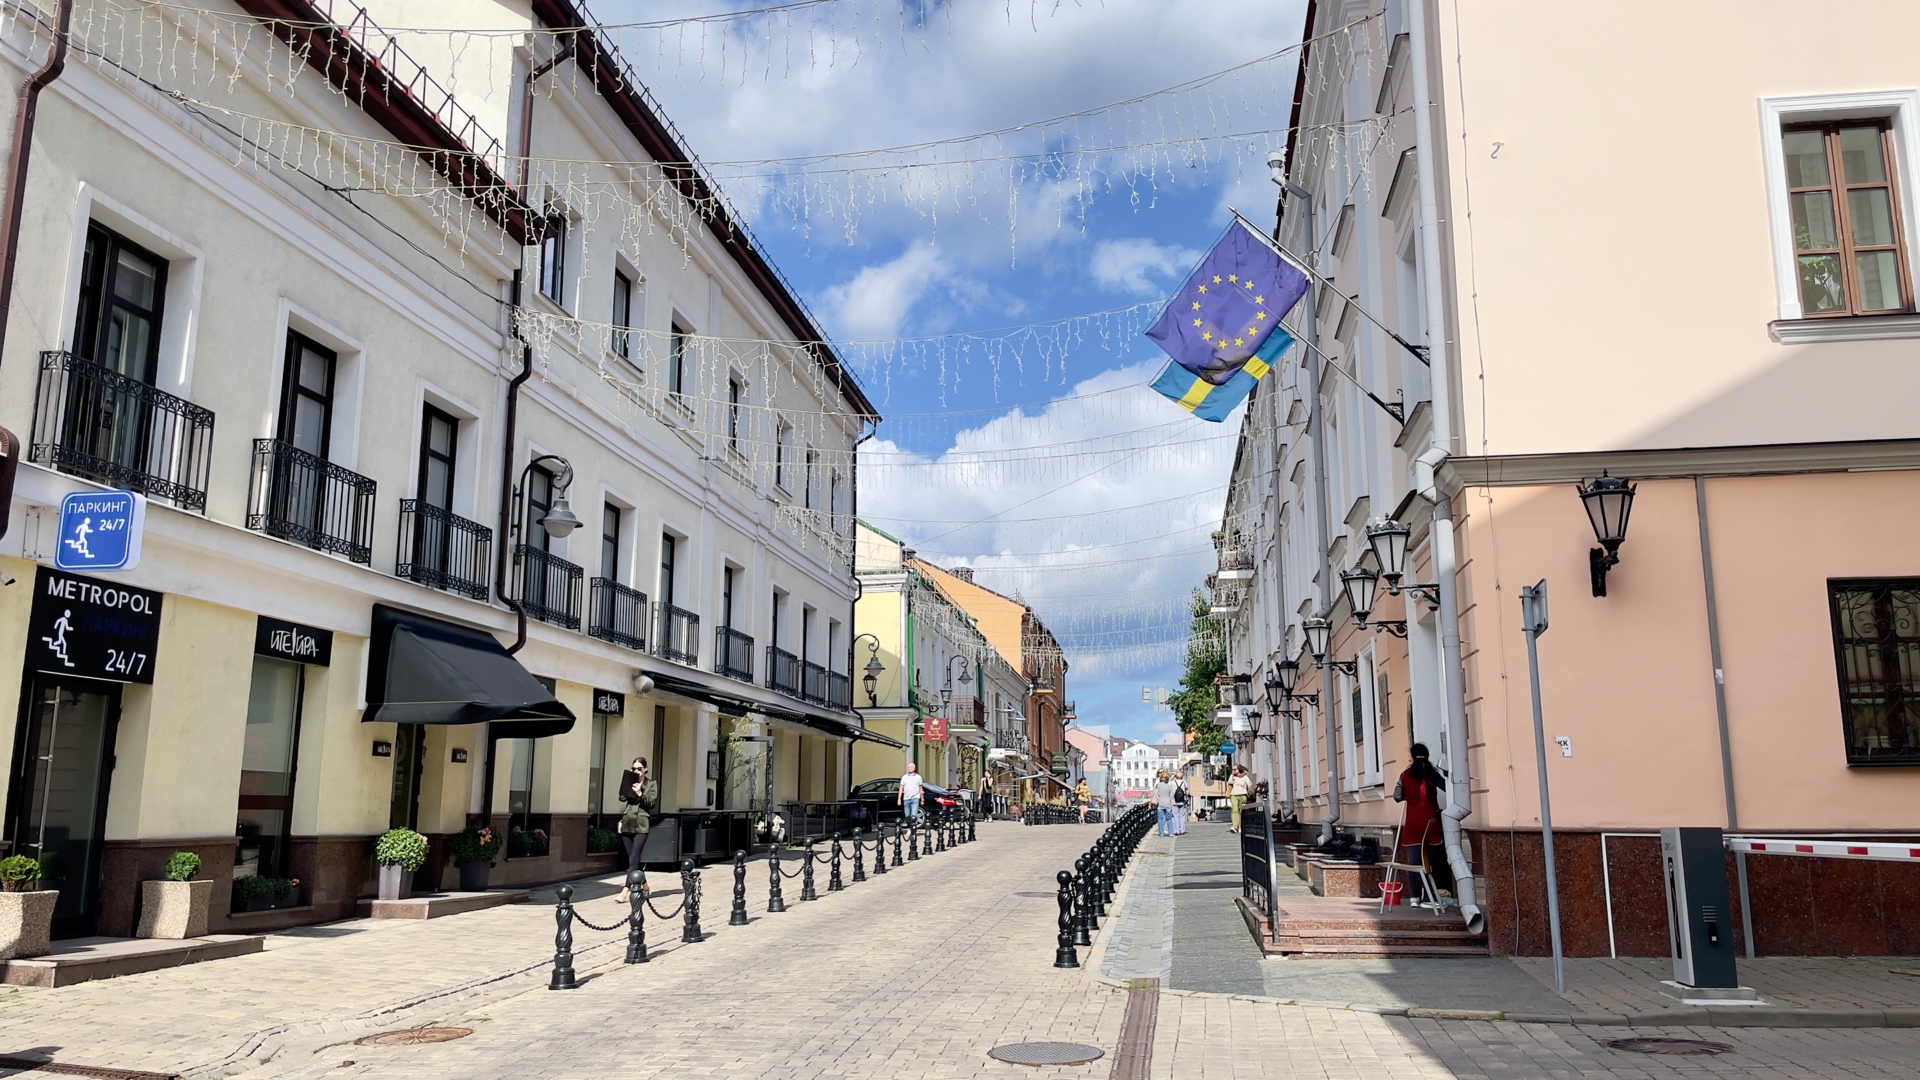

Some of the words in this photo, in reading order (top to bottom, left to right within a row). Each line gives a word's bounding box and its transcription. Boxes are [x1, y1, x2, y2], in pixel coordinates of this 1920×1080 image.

[68, 501, 127, 514] ПАРКИНГ
[99, 518, 126, 531] 24/7
[48, 576, 153, 615] METROPOL
[83, 614, 150, 640] ПАРКИНГ
[105, 649, 147, 675] 24/7
